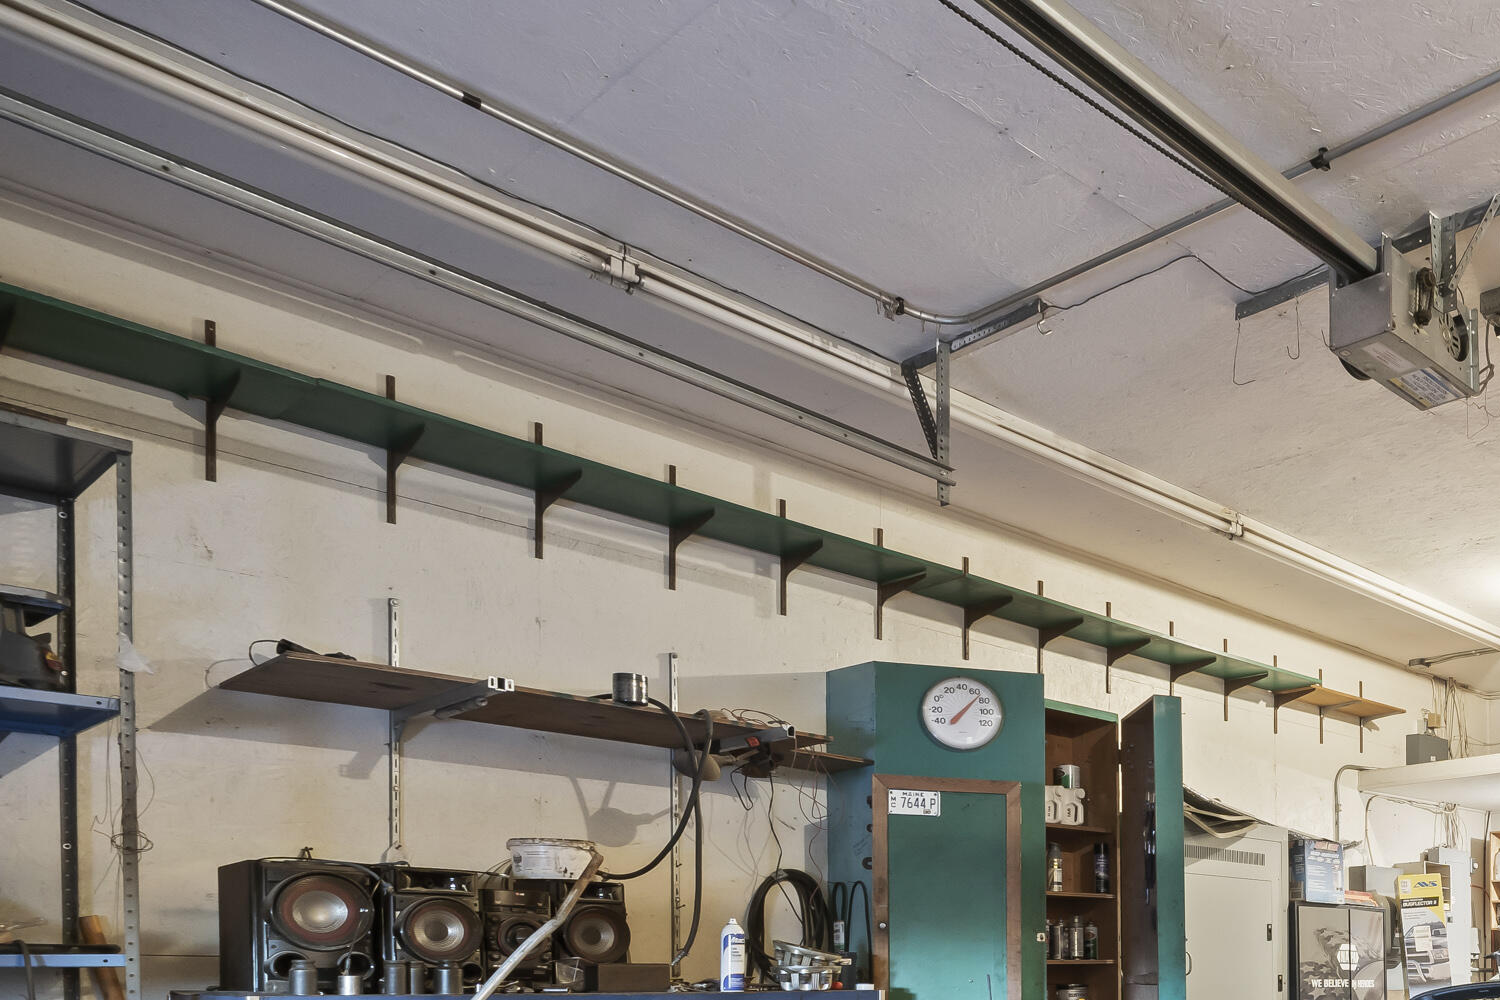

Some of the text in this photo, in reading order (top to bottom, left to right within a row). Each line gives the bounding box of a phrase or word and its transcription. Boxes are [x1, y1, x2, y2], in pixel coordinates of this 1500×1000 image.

[943, 686, 955, 694] 20
[956, 683, 968, 691] 40
[931, 717, 946, 725] -40
[978, 719, 993, 727] 120
[900, 796, 937, 810] 7644 P
[1311, 978, 1322, 988] WE
[1323, 978, 1350, 988] BELIEVE
